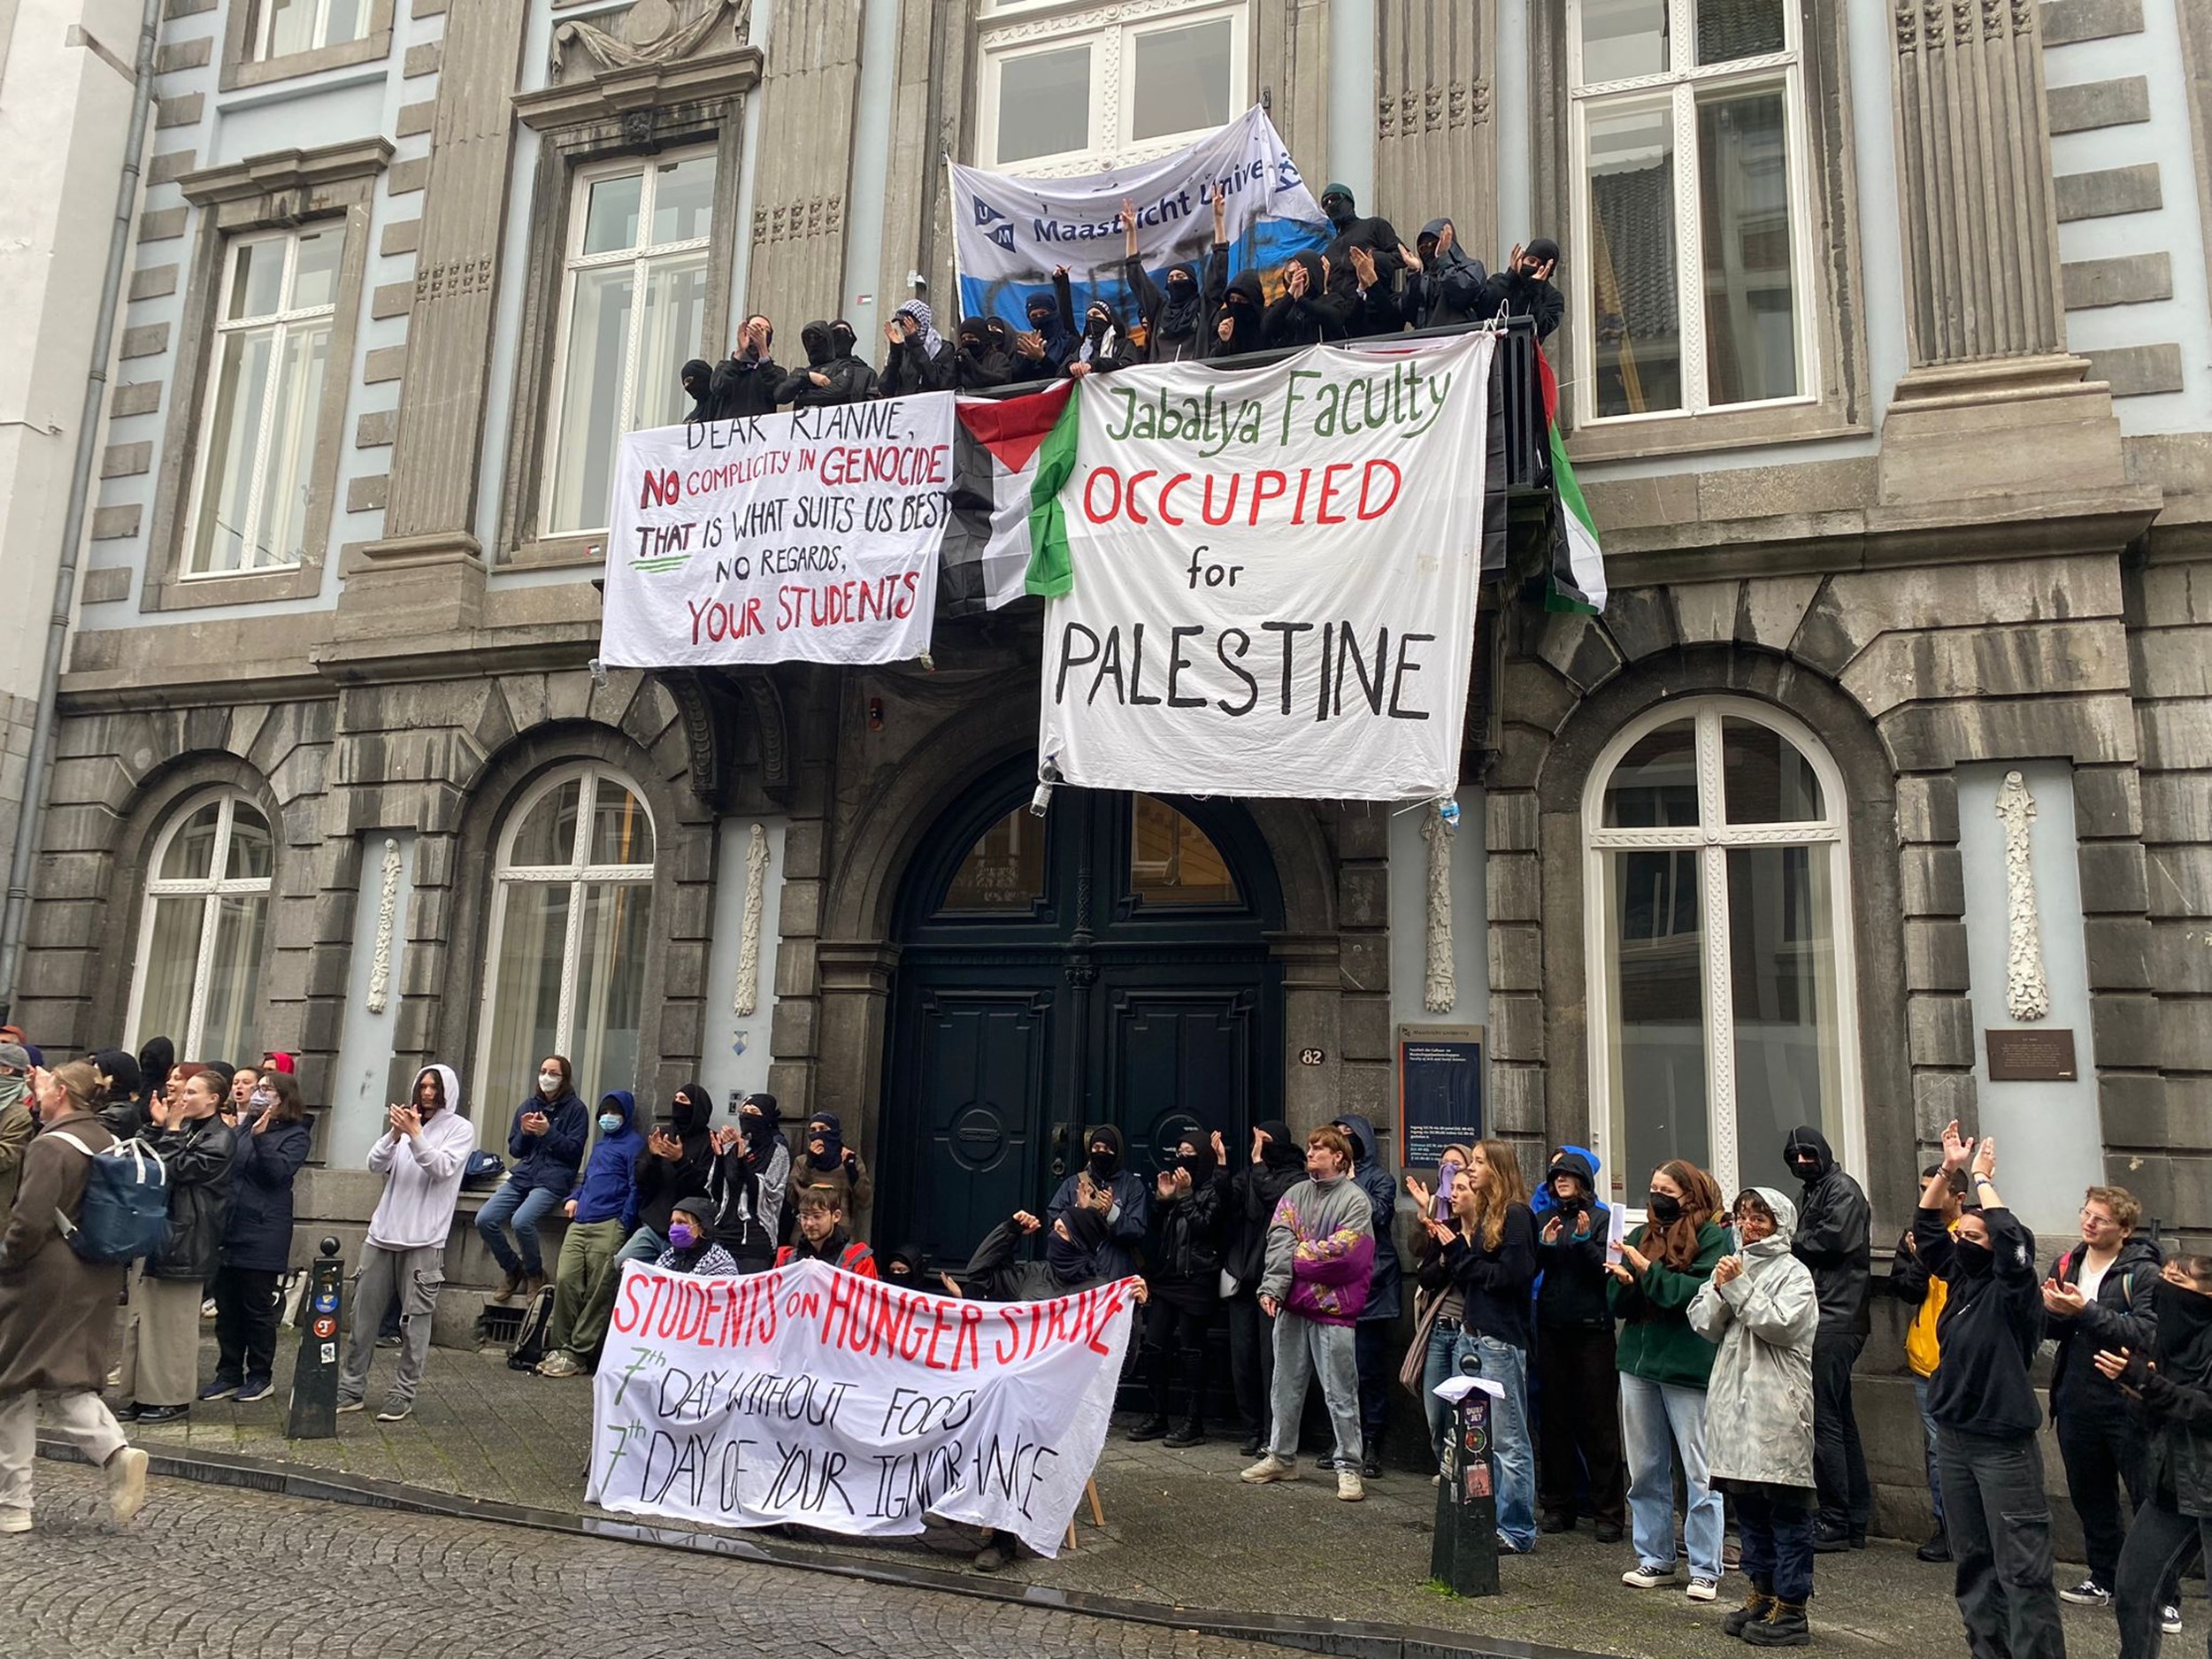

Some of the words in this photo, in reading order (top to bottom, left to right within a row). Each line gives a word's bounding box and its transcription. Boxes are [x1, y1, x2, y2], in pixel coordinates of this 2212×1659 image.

[1033, 191, 1192, 242] Maasticht
[687, 414, 766, 450] DEAR
[790, 402, 914, 441] RIANNE,
[1107, 385, 1263, 458] Jabalya
[1280, 362, 1452, 446] Faculty
[641, 468, 680, 509] NO
[687, 451, 791, 495] COMPLICITY
[798, 449, 816, 472] IN
[819, 445, 949, 486] GENOCIDE
[1083, 458, 1402, 526] OCCUPIED
[636, 523, 696, 557] THAT
[703, 519, 721, 549] IS
[733, 498, 788, 541] WHAT
[795, 496, 854, 533] SUITS
[864, 496, 895, 531] US
[900, 491, 950, 531] BEST
[717, 556, 749, 582] NO
[761, 545, 847, 576] REGARDS,
[1187, 545, 1244, 588] for
[687, 597, 765, 645] YOUR
[777, 572, 920, 631] STUDENTS
[1056, 620, 1435, 722] PALESTINE
[1302, 1050, 1322, 1064] 82
[614, 1272, 783, 1348] STUDENTS
[786, 1292, 819, 1318] ON
[821, 1271, 983, 1372] HUNGER
[614, 1347, 666, 1406] 7th
[658, 1368, 728, 1421] DAY
[726, 1371, 858, 1430] WITHOUT
[880, 1387, 977, 1436] FOOD
[601, 1419, 647, 1496] 7th
[640, 1430, 717, 1507] DAY
[719, 1440, 757, 1514] OF
[762, 1440, 856, 1515] YOUR
